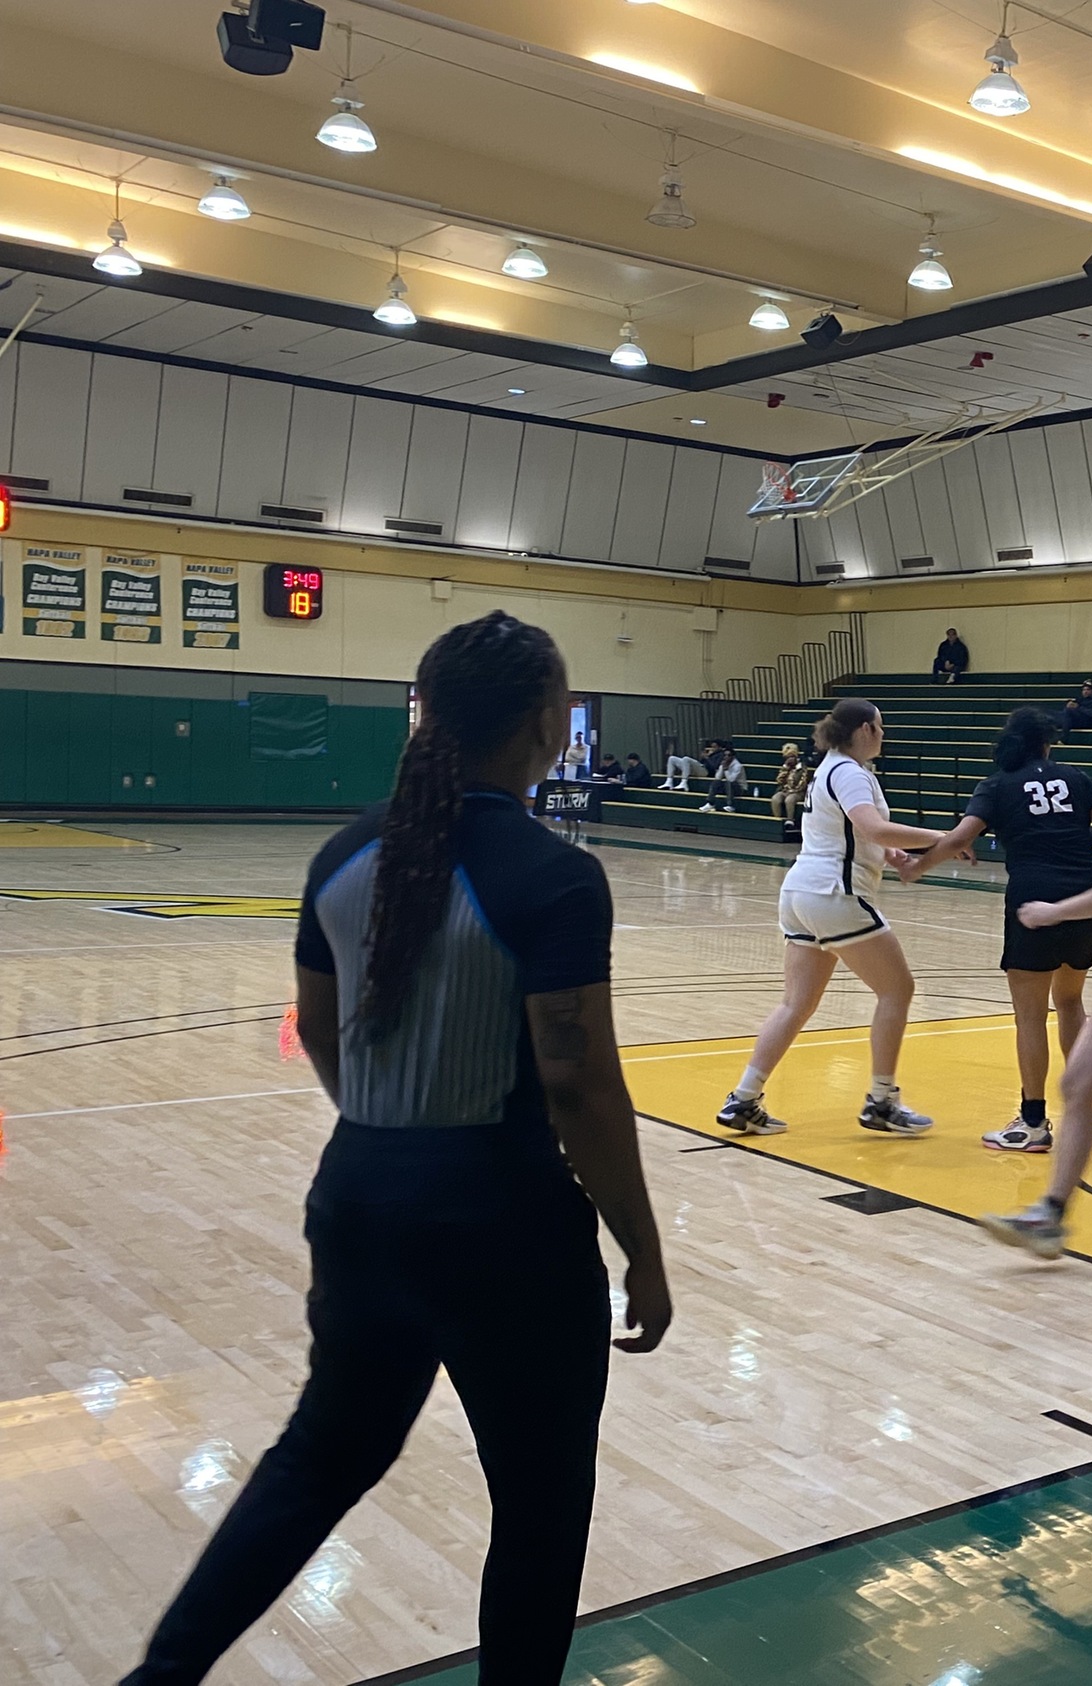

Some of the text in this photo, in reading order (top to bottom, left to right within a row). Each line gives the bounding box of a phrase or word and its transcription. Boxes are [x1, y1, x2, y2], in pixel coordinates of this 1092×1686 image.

[53, 551, 82, 560] VALLEY
[208, 566, 234, 575] VALLEY
[283, 571, 319, 590] 3:49
[290, 592, 309, 615] 18
[545, 792, 590, 810] STORM
[1024, 779, 1073, 815] 32
